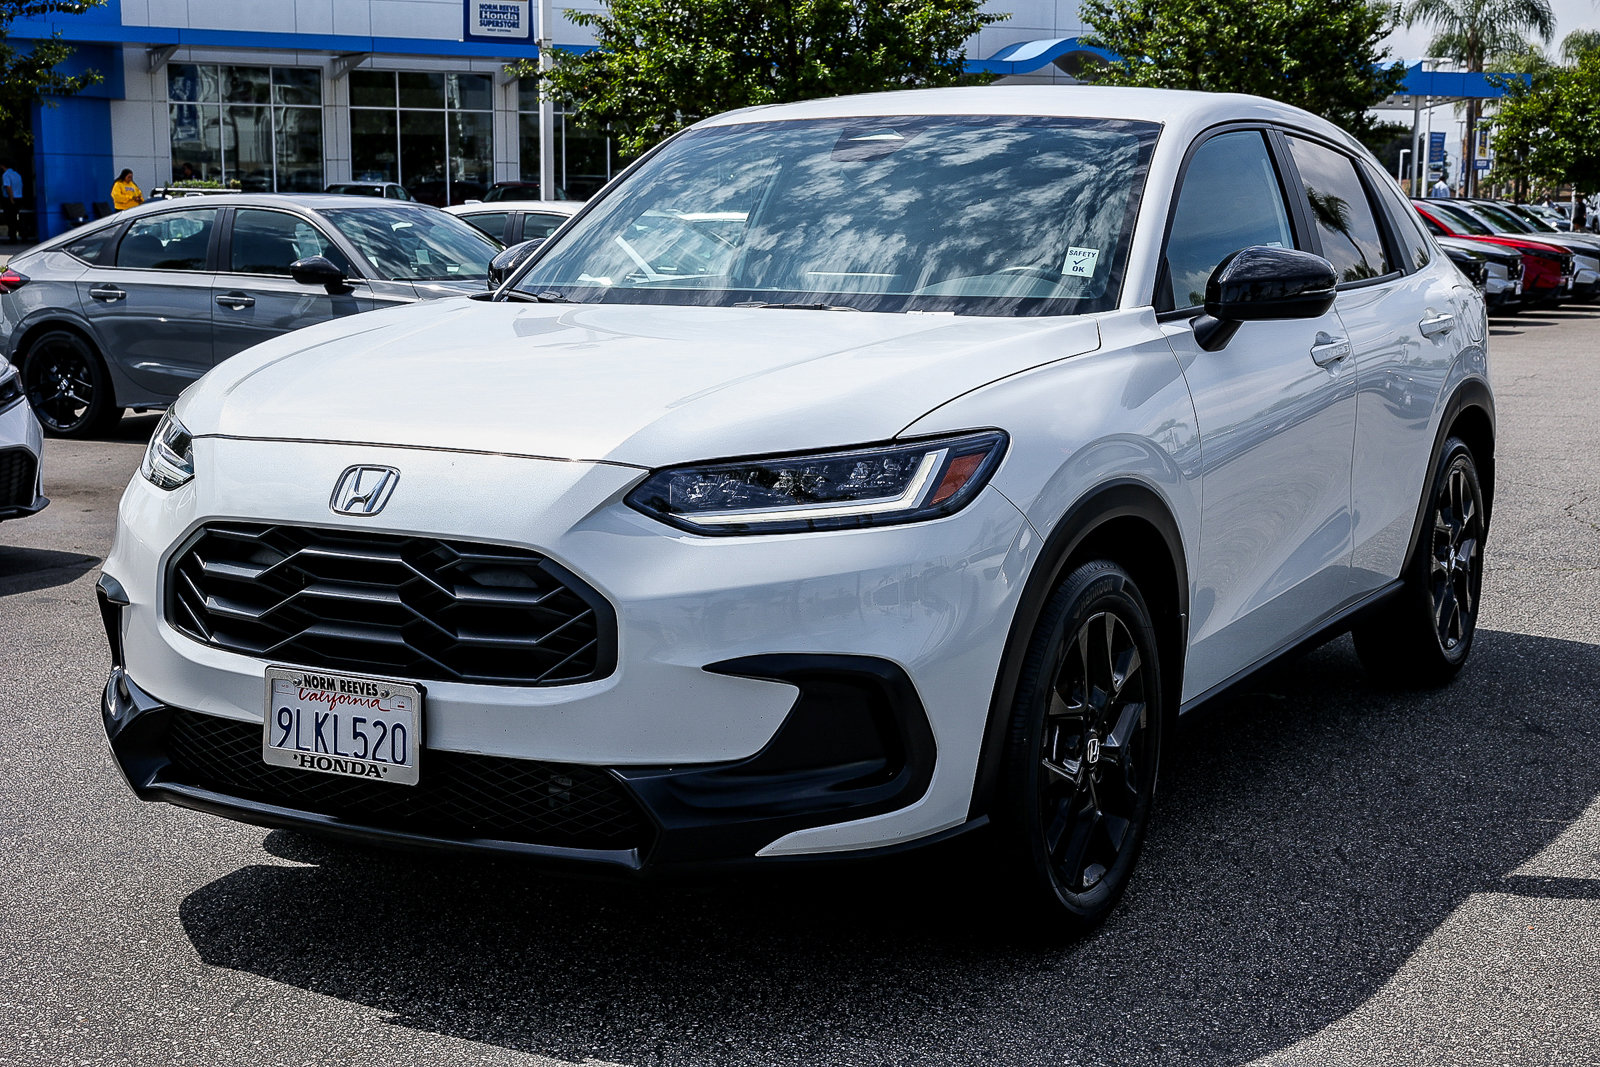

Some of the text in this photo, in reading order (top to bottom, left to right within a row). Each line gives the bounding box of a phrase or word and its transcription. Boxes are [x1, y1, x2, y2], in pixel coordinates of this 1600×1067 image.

[479, 3, 520, 12] NORM REEVES
[481, 11, 518, 20] Honda
[479, 20, 520, 28] SUPERSTORE
[1068, 249, 1097, 258] SAFETY
[1072, 265, 1085, 273] OK
[303, 674, 379, 697] NORM REEVES
[298, 687, 391, 712] California
[275, 706, 407, 766] 9LKL520
[299, 754, 385, 779] HONDA
